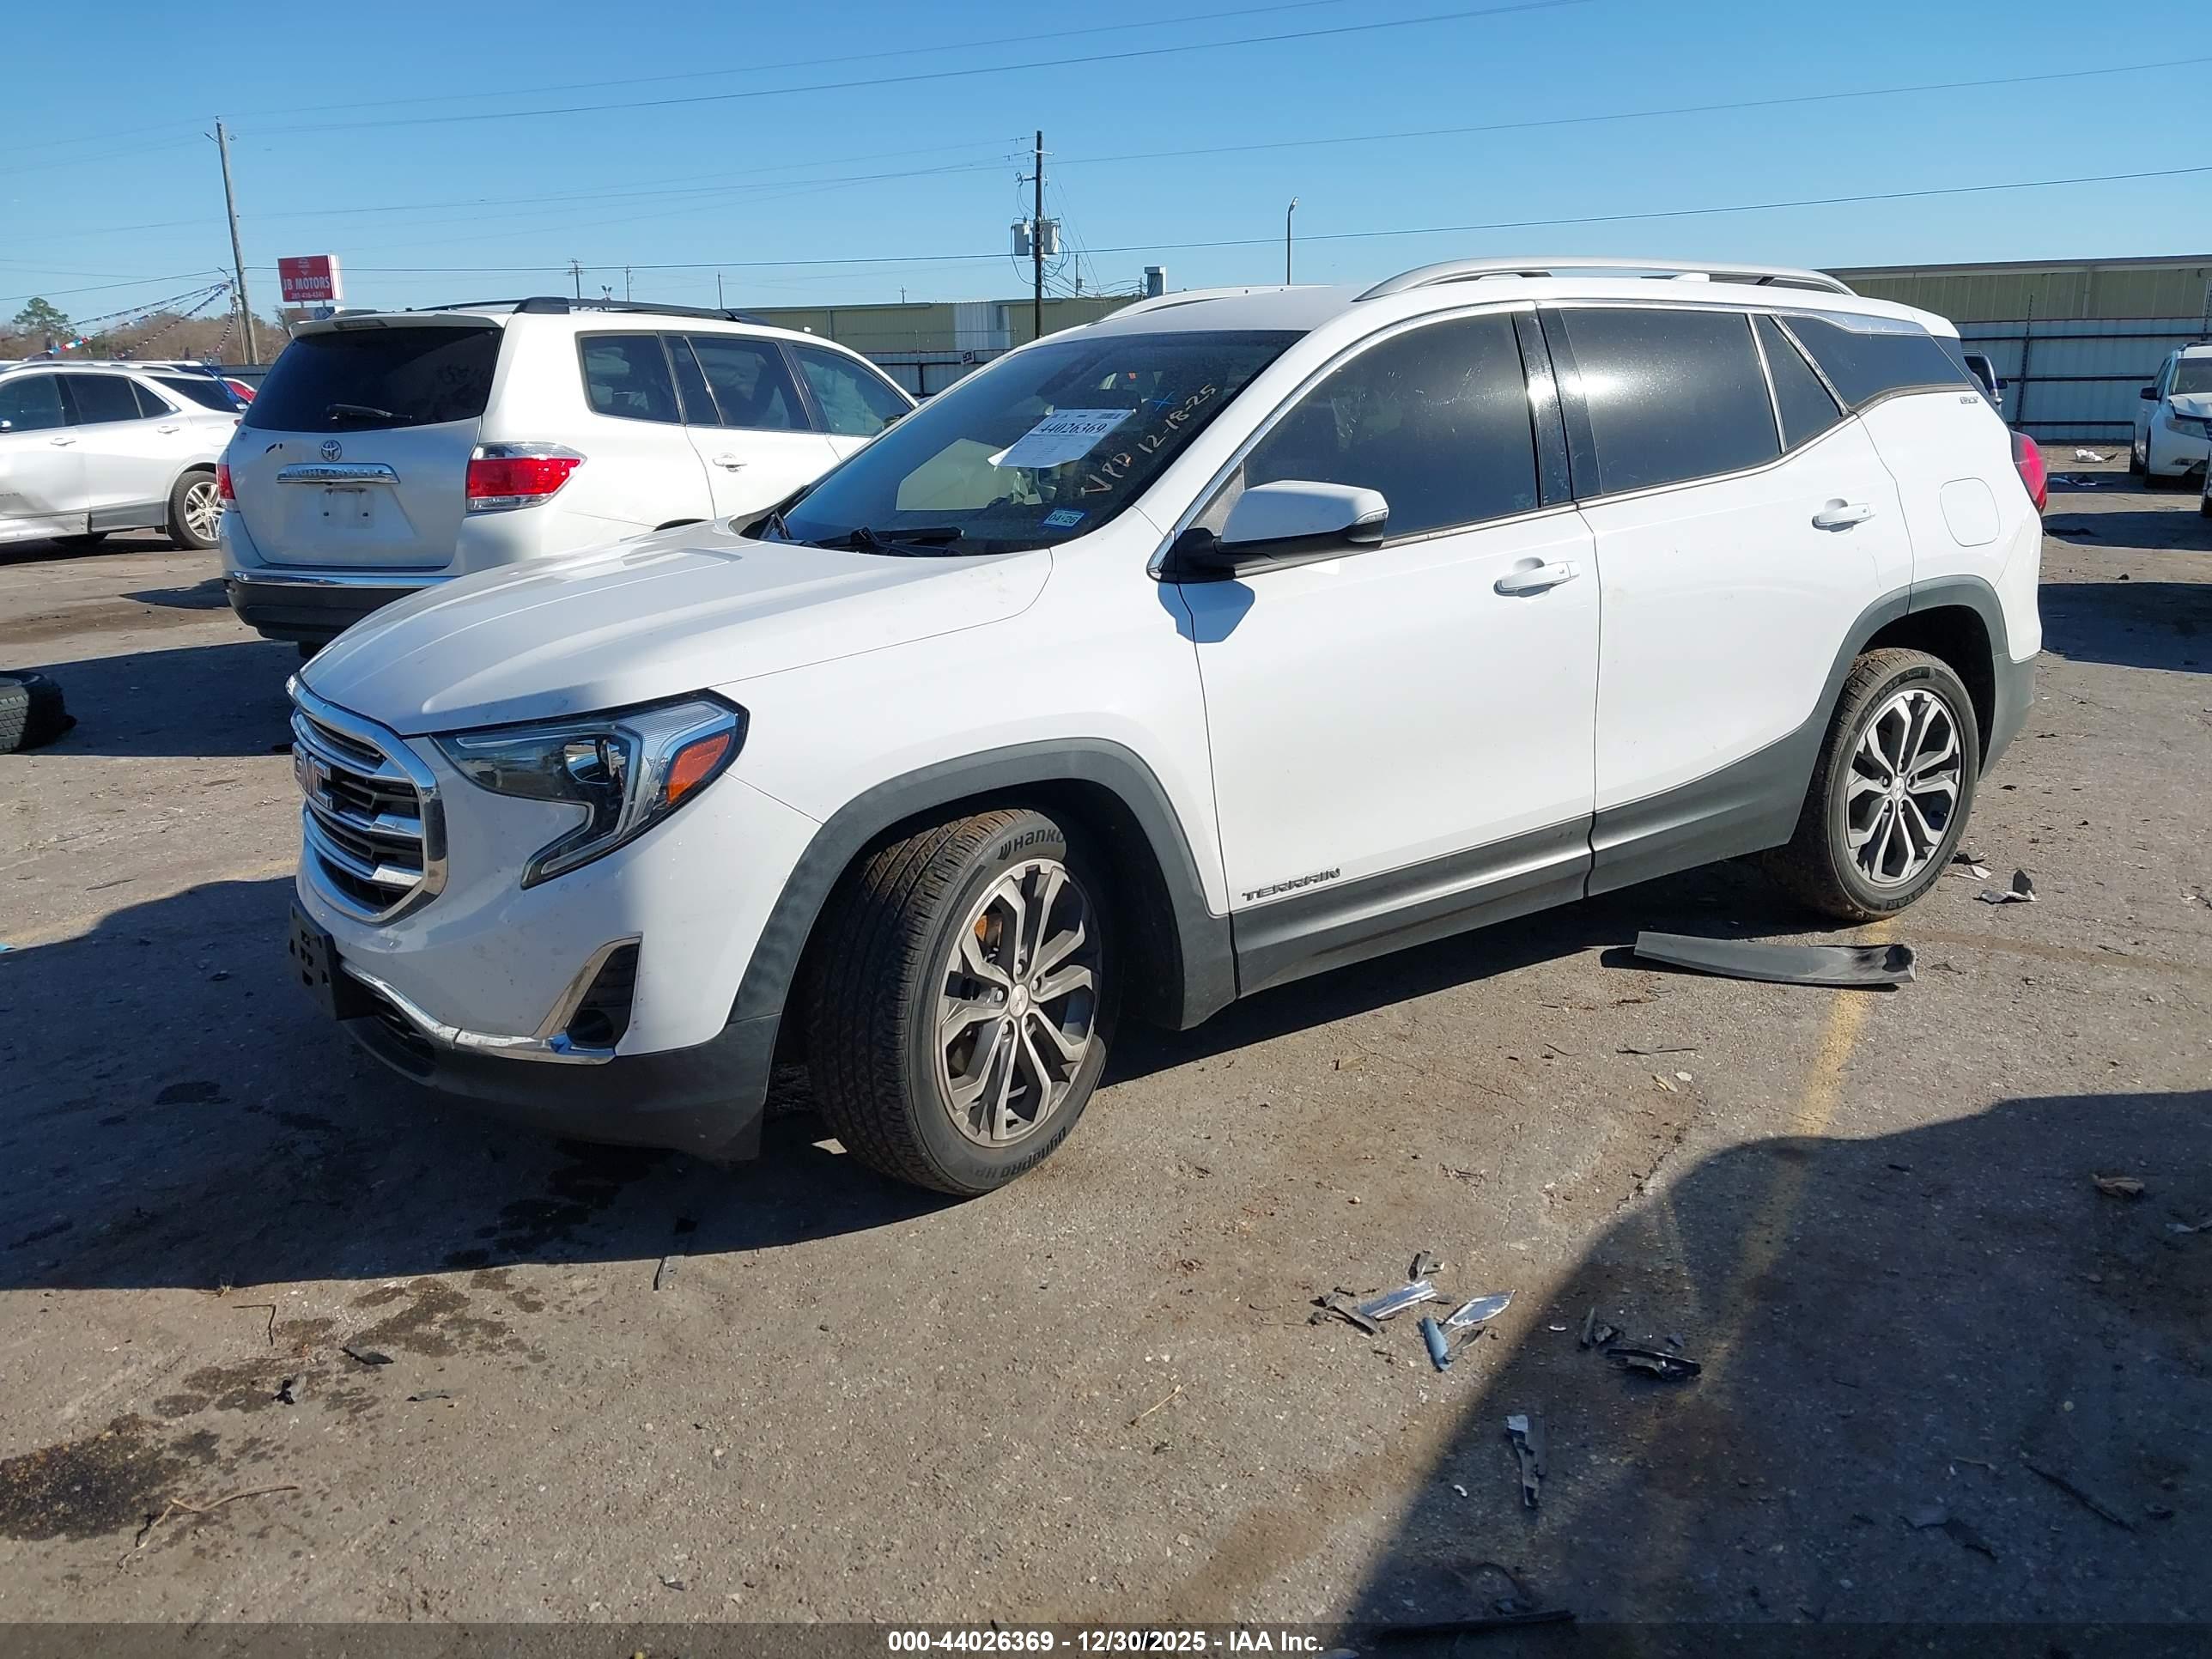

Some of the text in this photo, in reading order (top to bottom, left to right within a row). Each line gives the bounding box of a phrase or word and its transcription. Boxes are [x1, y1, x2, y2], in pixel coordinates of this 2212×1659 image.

[283, 276, 330, 290] JB MOTORS
[1040, 422, 1108, 434] 44026369
[1138, 384, 1216, 453] 12-18-25
[1242, 868, 1340, 901] TERRAIN
